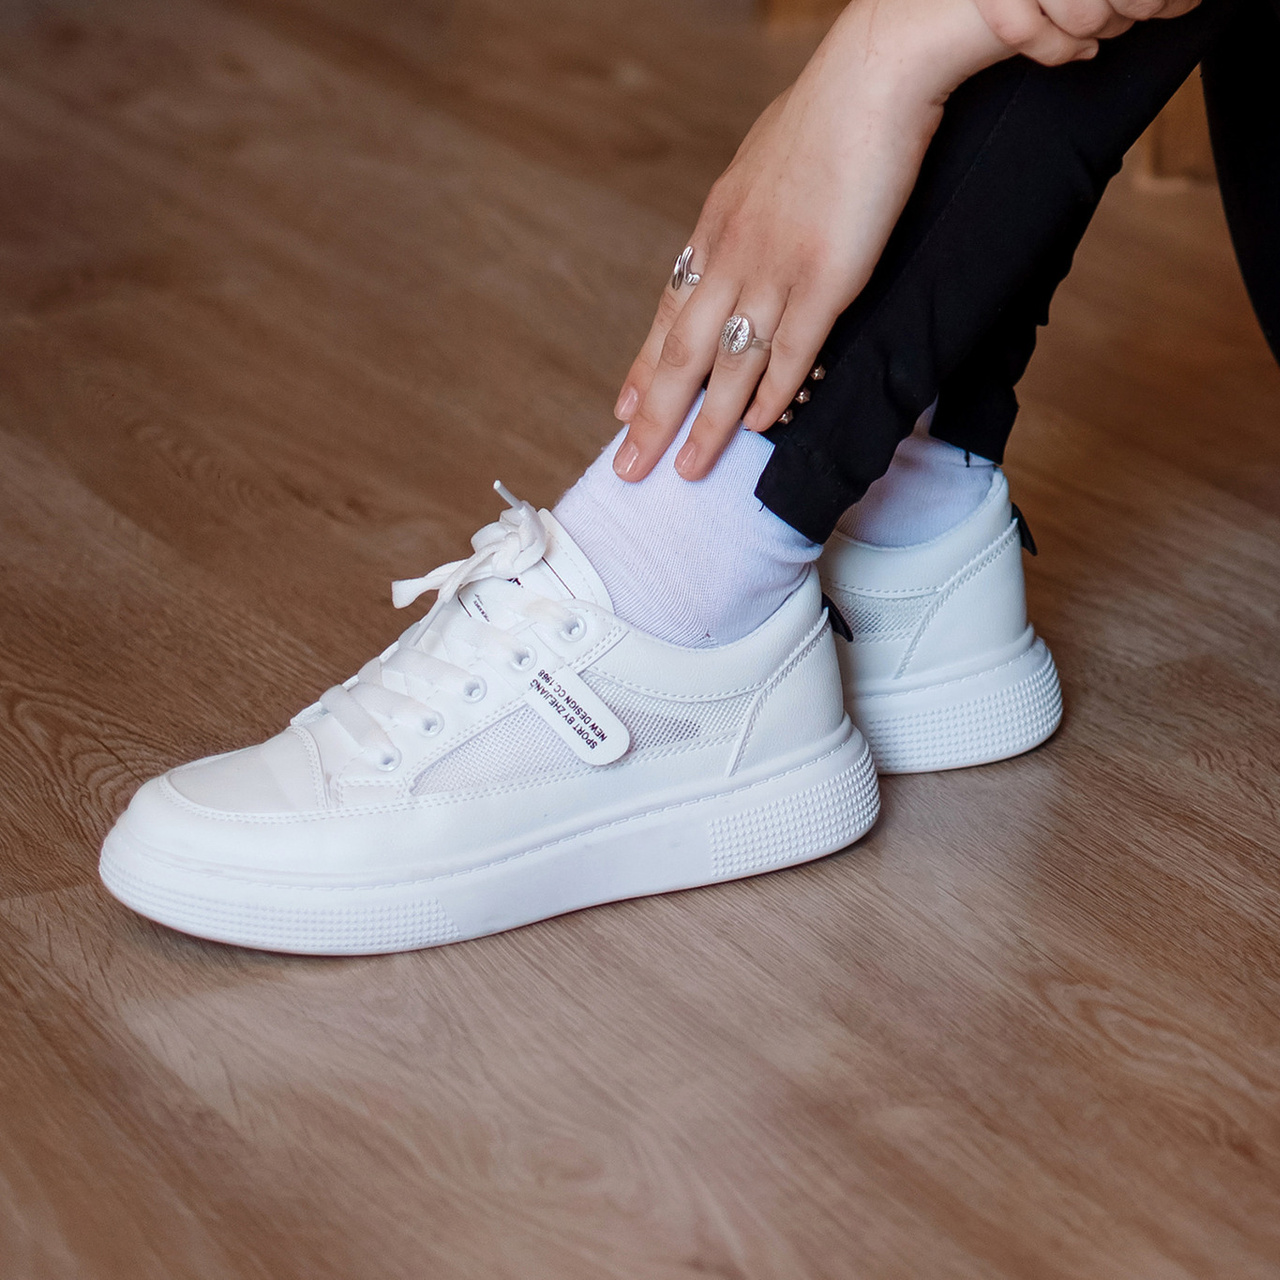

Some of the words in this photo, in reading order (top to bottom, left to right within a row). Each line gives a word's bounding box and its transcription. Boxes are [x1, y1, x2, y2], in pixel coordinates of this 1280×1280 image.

[530, 678, 567, 715] ZHEJIANG
[562, 712, 576, 726] BY
[564, 695, 592, 726] DESIGN
[572, 723, 599, 750] SPORT
[588, 722, 608, 743] NEW
